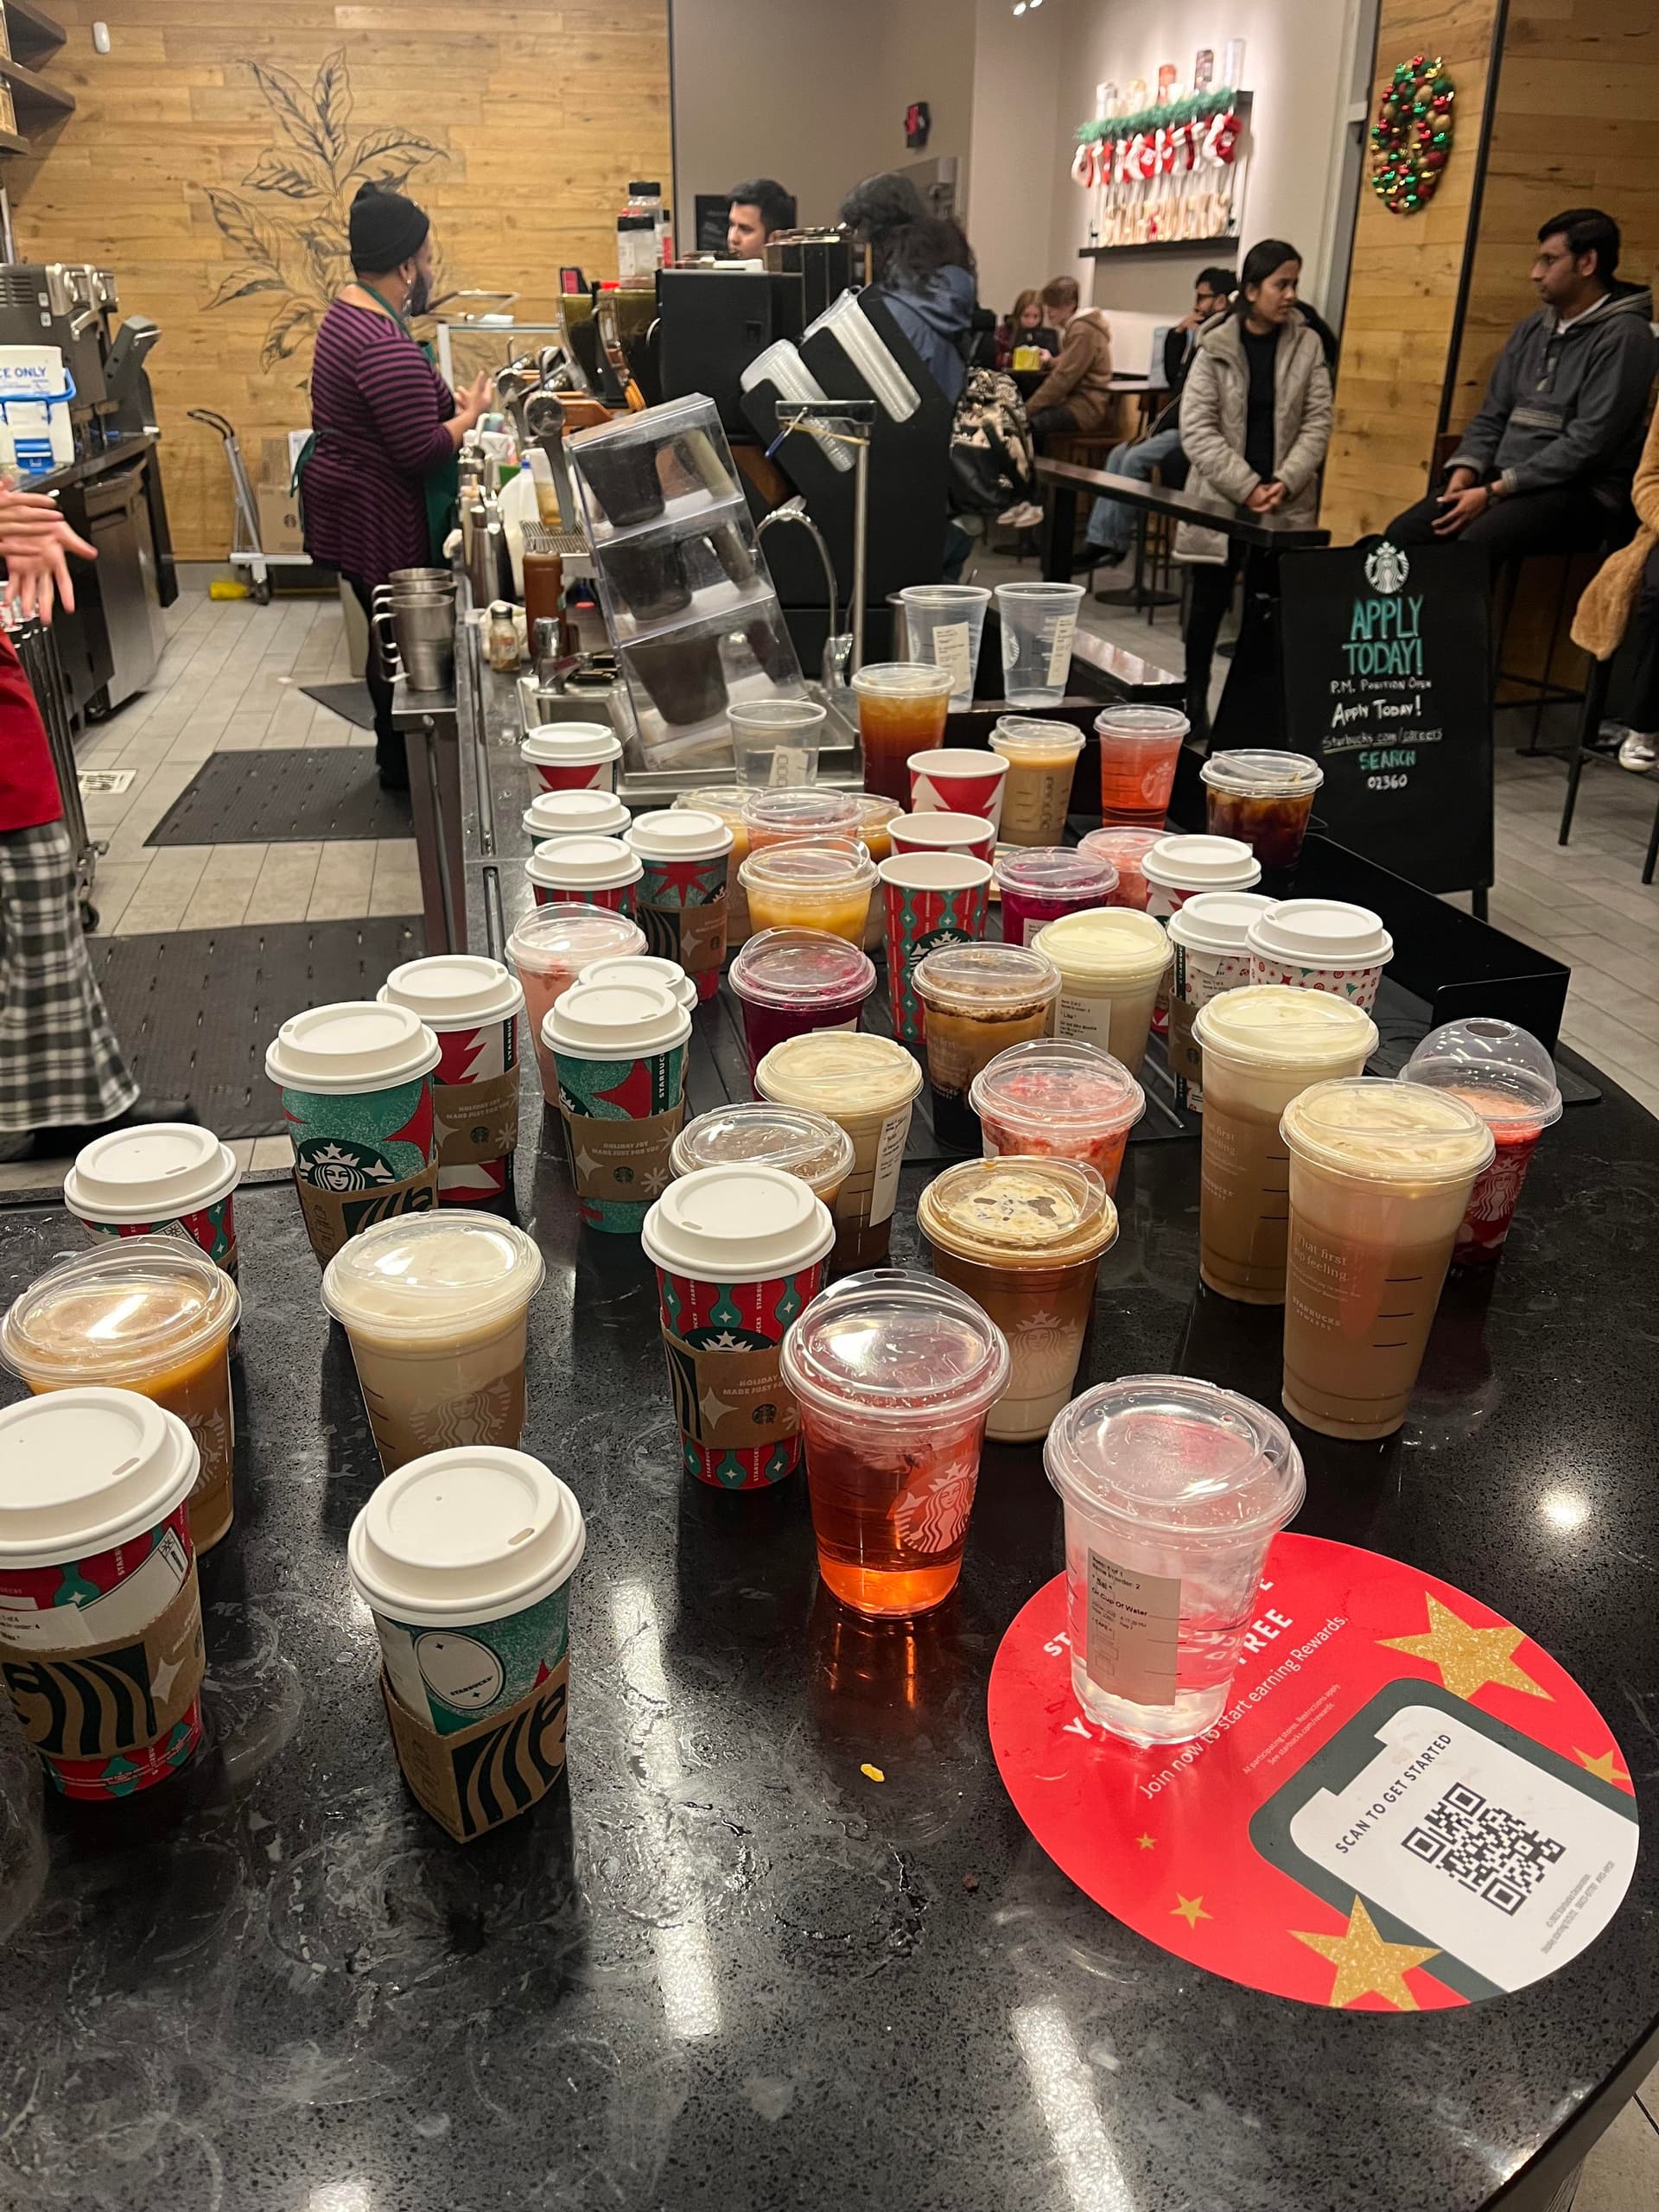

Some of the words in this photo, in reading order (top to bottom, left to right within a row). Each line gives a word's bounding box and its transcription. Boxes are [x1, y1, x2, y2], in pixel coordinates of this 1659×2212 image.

[14, 366, 47, 378] ONLY
[1351, 594, 1424, 640] APPLY
[1342, 638, 1424, 677] TODAY!
[1358, 749, 1416, 771] SEARCH
[1367, 773, 1408, 790] 02360
[1321, 1249, 1346, 1266] first
[739, 1374, 778, 1387] HOLIDAY
[751, 1385, 771, 1394] JUST
[1100, 1592, 1115, 1605] Cup
[1116, 1600, 1124, 1610] Of
[1125, 1605, 1148, 1617] Water
[1139, 1767, 1174, 1800] Join
[1171, 1742, 1204, 1772] now
[1200, 1726, 1221, 1745] to
[1217, 1697, 1253, 1732] start
[1249, 1657, 1301, 1702] earning
[1290, 1617, 1349, 1662] Rewards.
[1249, 1735, 1285, 1770] participating
[1295, 1695, 1327, 1723] Restrictions
[1267, 1755, 1280, 1765] See
[1335, 1819, 1371, 1854] SCAN
[1365, 1802, 1387, 1821] TO
[1382, 1779, 1408, 1803] GET
[1403, 1733, 1452, 1782] STARTED
